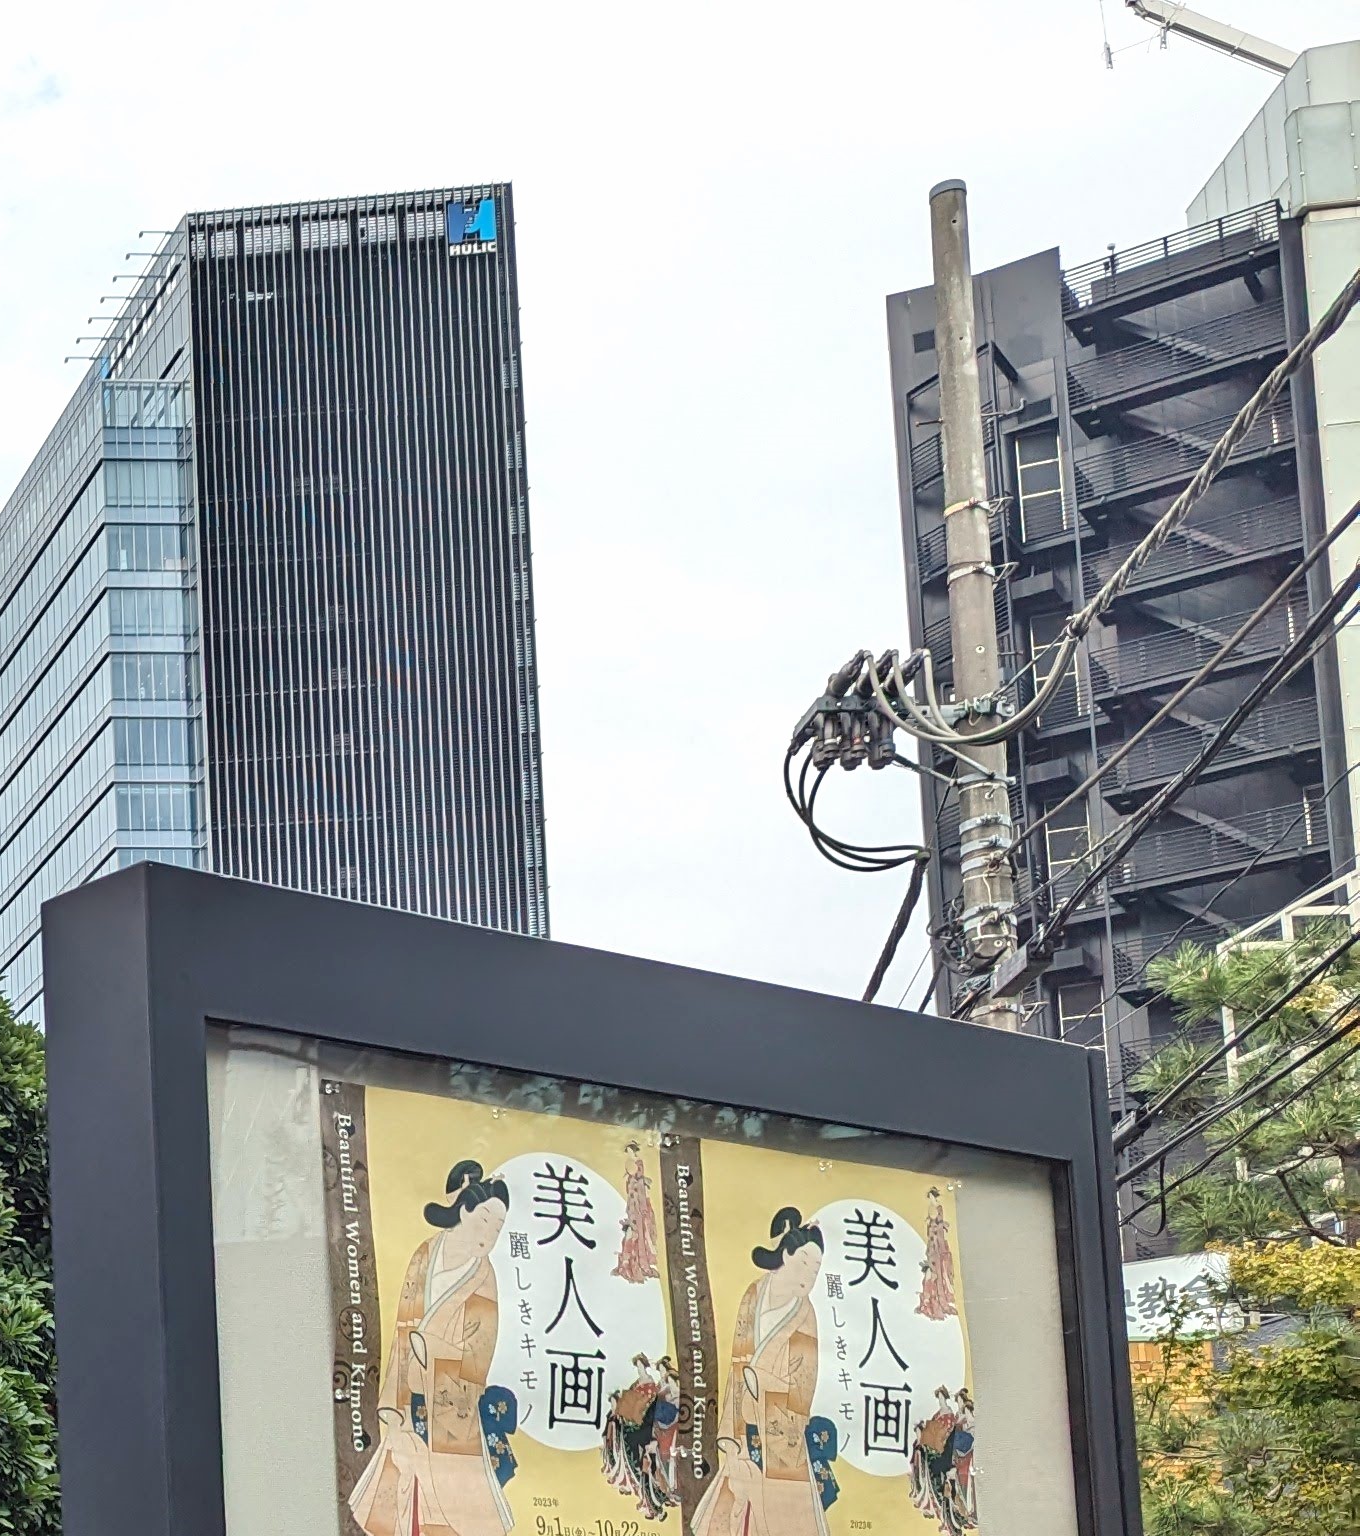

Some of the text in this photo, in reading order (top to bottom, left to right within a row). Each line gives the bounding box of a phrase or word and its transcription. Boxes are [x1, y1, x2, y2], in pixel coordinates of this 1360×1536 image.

[449, 241, 497, 256] HULIC
[335, 1112, 368, 1452] Beautiful Women and Kimono
[508, 1231, 538, 1425] 麗しきキモノ
[533, 1161, 607, 1430] 美人画
[676, 1163, 707, 1480] Beautiful Women and Kimono
[825, 1273, 855, 1452] 麗しきキモノ
[843, 1208, 912, 1458] 美人画
